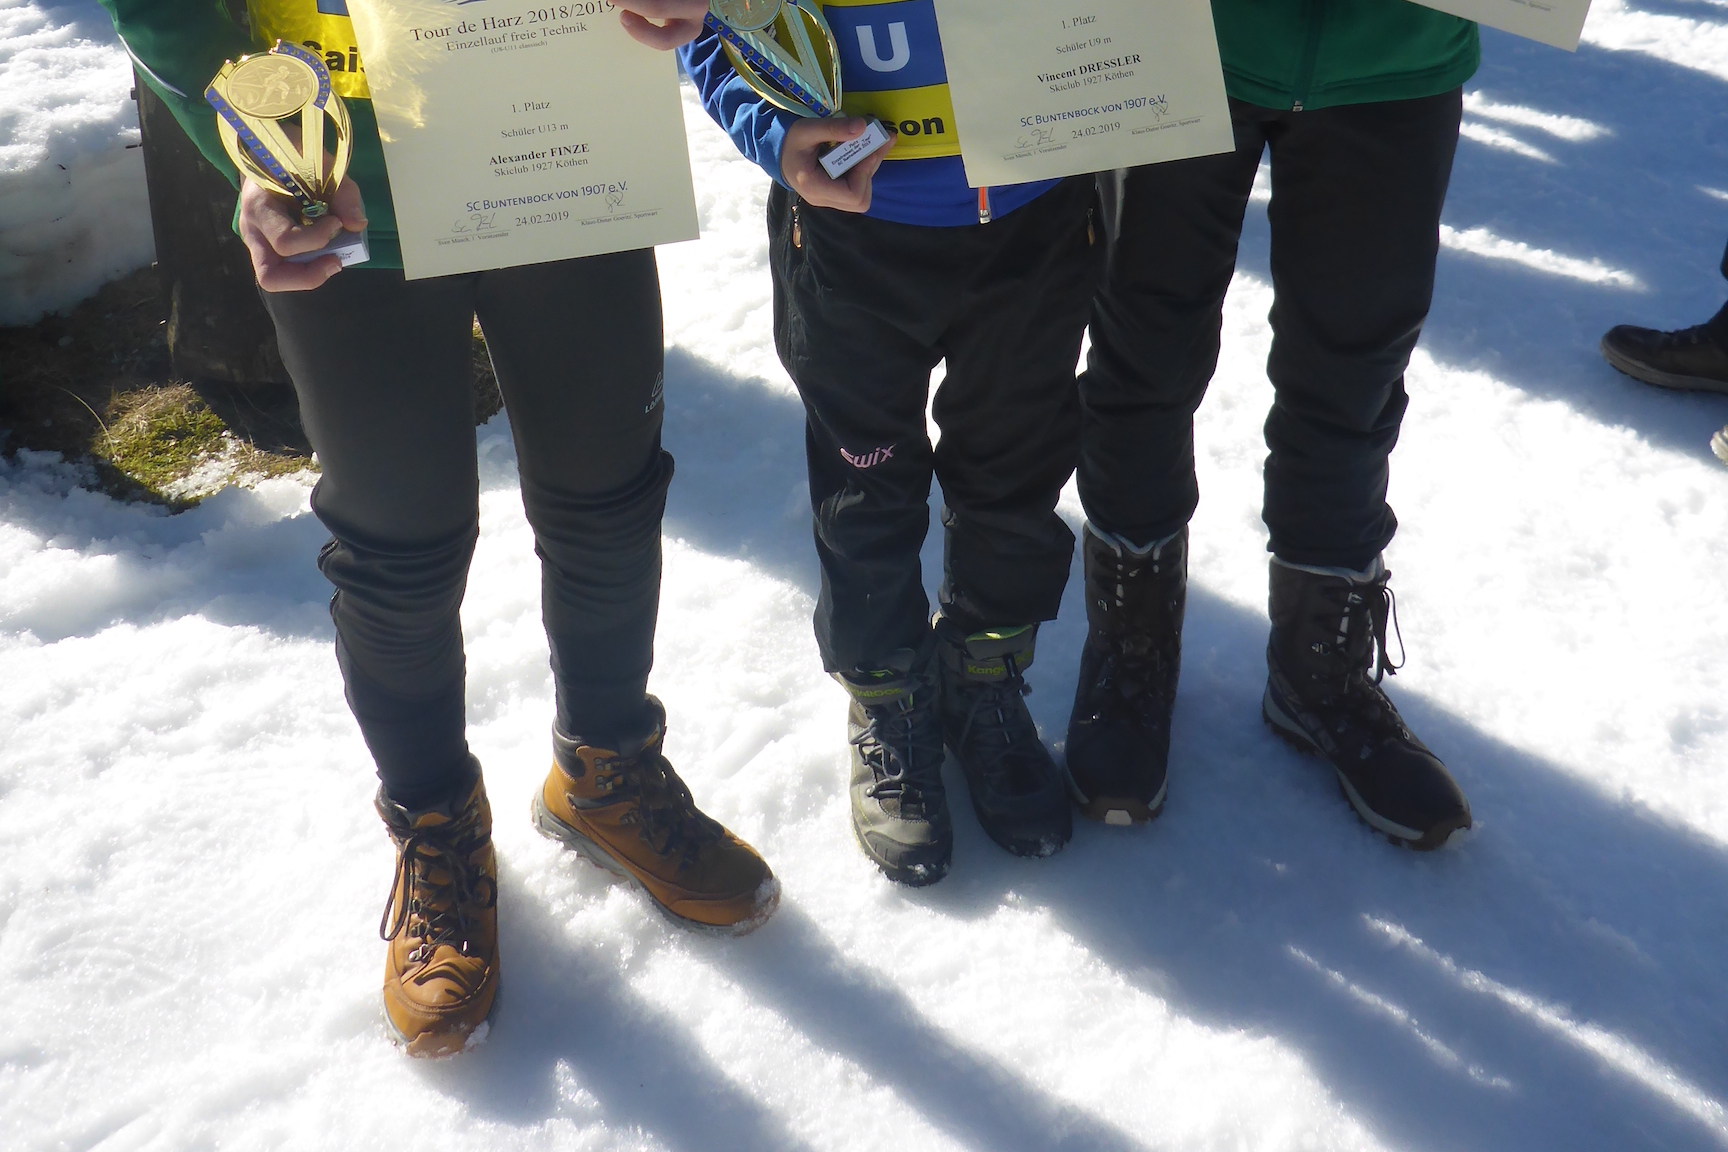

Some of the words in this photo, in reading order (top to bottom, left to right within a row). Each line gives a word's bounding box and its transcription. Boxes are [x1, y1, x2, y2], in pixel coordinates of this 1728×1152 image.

[409, 25, 451, 41] Tour
[457, 20, 477, 35] de
[482, 16, 524, 31] Harz
[528, 0, 615, 25] 2018/2019
[1062, 20, 1070, 29] 1.
[1072, 15, 1097, 27] Platz
[446, 32, 508, 51] Einzellauf
[510, 29, 537, 42] freie
[540, 22, 588, 37] Technik
[856, 22, 910, 72] U
[1055, 42, 1087, 54] Schüler
[1088, 37, 1101, 48] U9
[1103, 36, 1112, 44] m
[1037, 69, 1077, 83] Vincent
[1079, 53, 1141, 75] DRESSLER
[1049, 80, 1081, 93] Skiclub
[1083, 75, 1102, 87] 1927
[1104, 70, 1134, 83] Köthen
[512, 104, 521, 113] 1.
[524, 101, 551, 112] Platz
[1020, 117, 1033, 127] SC
[1124, 97, 1147, 110] 1907
[1149, 94, 1167, 105] e.V.
[501, 127, 535, 138] Schüler
[538, 123, 557, 134] U13
[1072, 122, 1121, 140] 24.02.2019
[489, 149, 547, 165] Alexander
[550, 143, 590, 157] FINZE
[494, 164, 529, 177] Skiclub
[532, 161, 553, 172] 1927
[555, 157, 589, 169] Köthen
[466, 201, 480, 212] SC
[581, 184, 606, 196] 1907
[608, 181, 628, 192] e.V.
[515, 211, 569, 227] 24.02.2019
